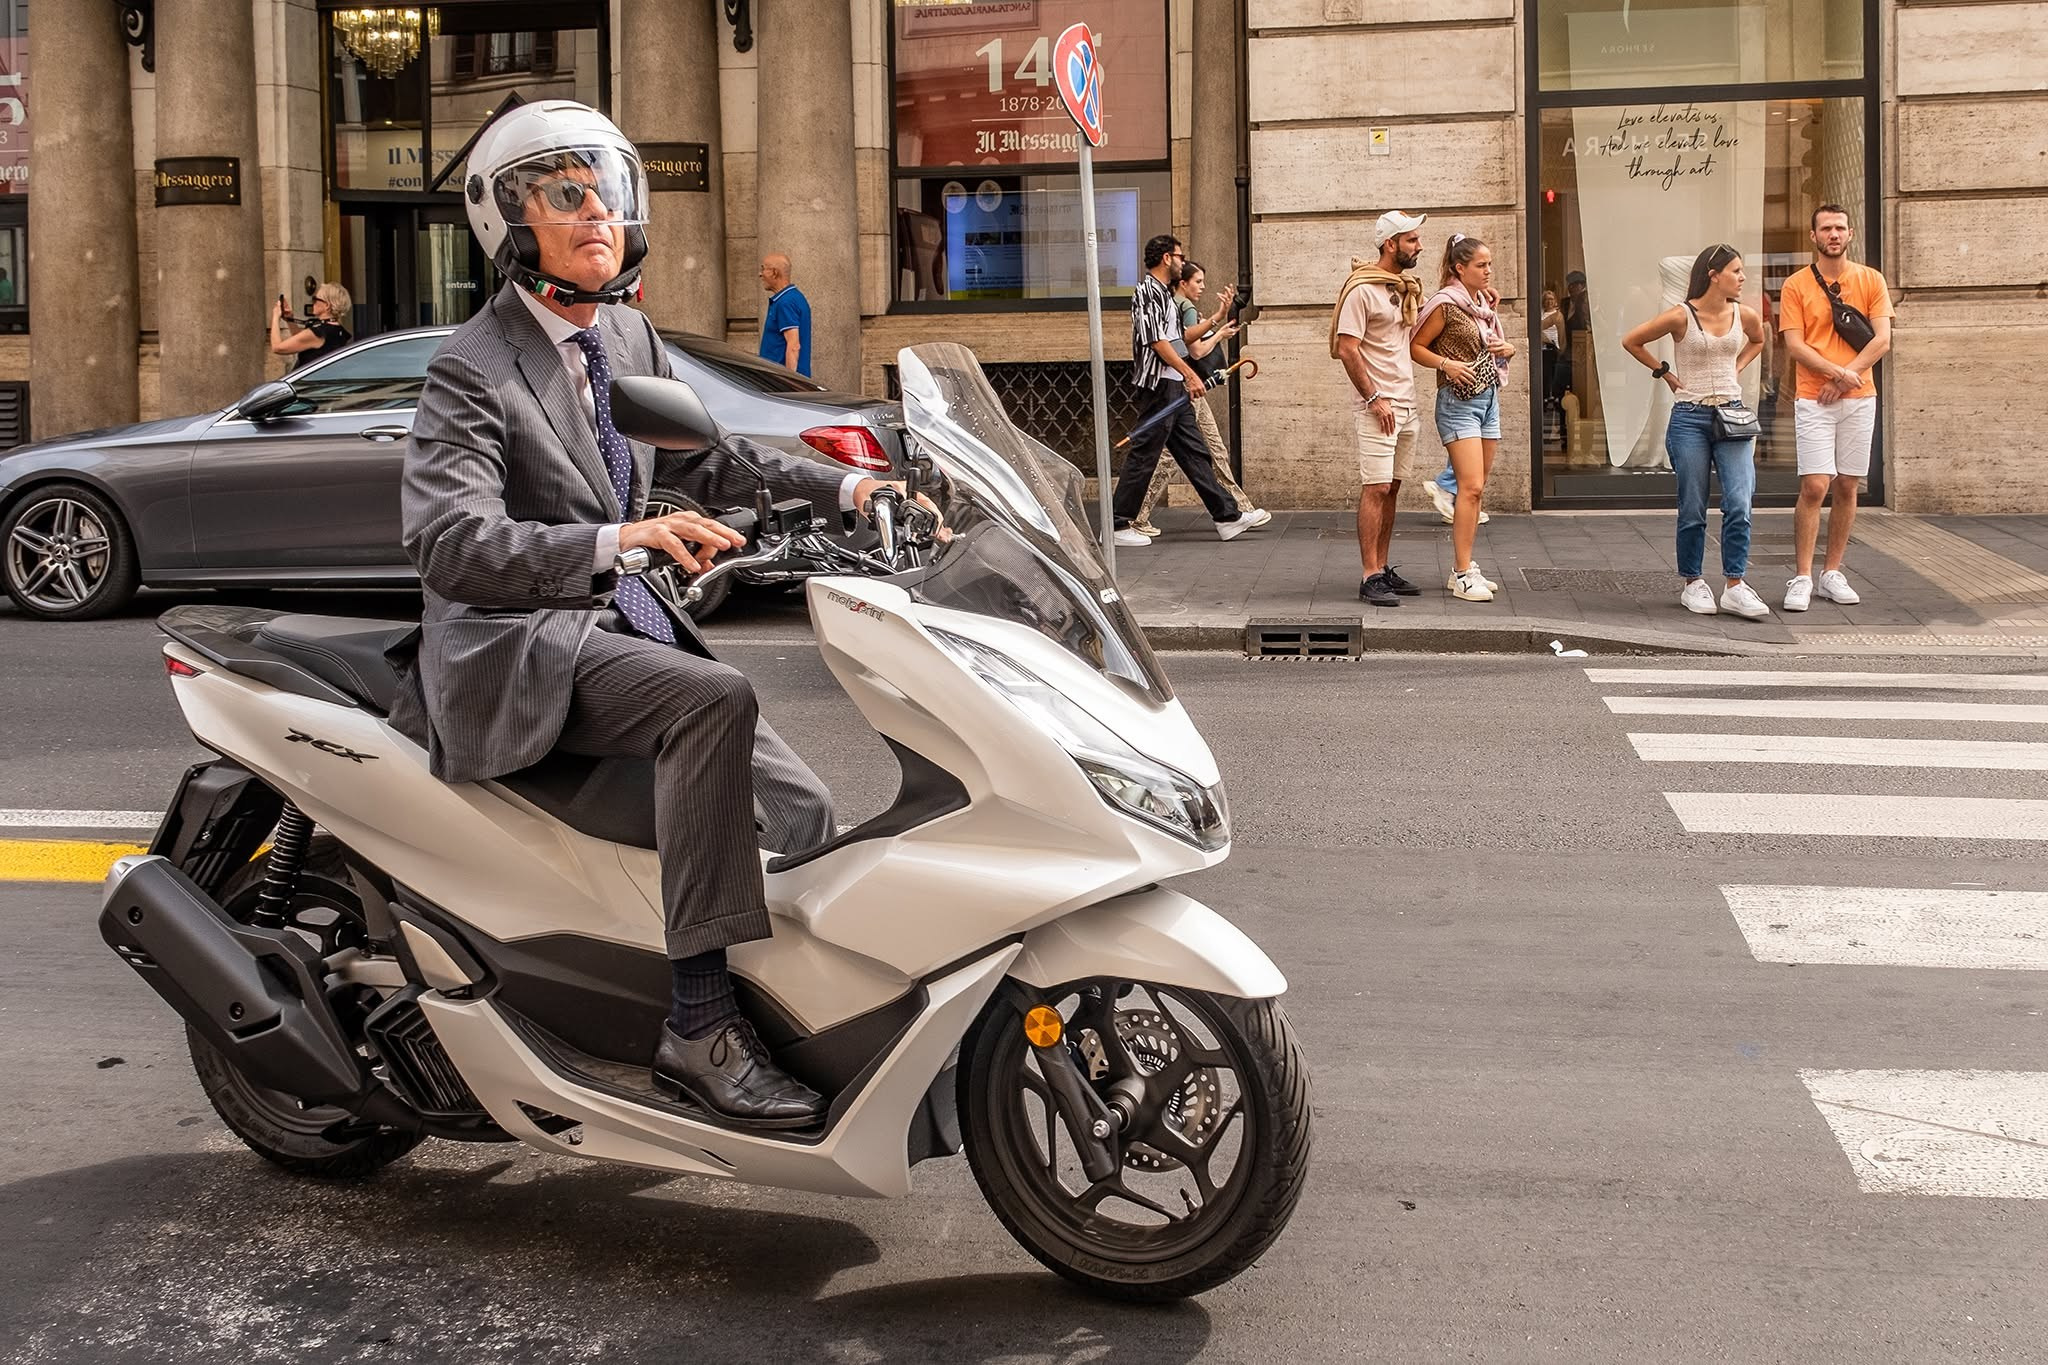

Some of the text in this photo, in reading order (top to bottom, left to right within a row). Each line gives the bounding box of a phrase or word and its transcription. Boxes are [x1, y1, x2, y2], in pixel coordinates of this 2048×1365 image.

[1000, 96, 1065, 112] 1878-20
[1617, 108, 1645, 130] Love
[1650, 103, 1701, 126] elevates
[999, 129, 1109, 153] Messaggo
[1600, 125, 1741, 158] And we elevate love
[643, 160, 702, 176] ssaggero
[1625, 155, 1687, 191] through
[445, 281, 476, 289] entrata
[284, 727, 380, 764] PCX
